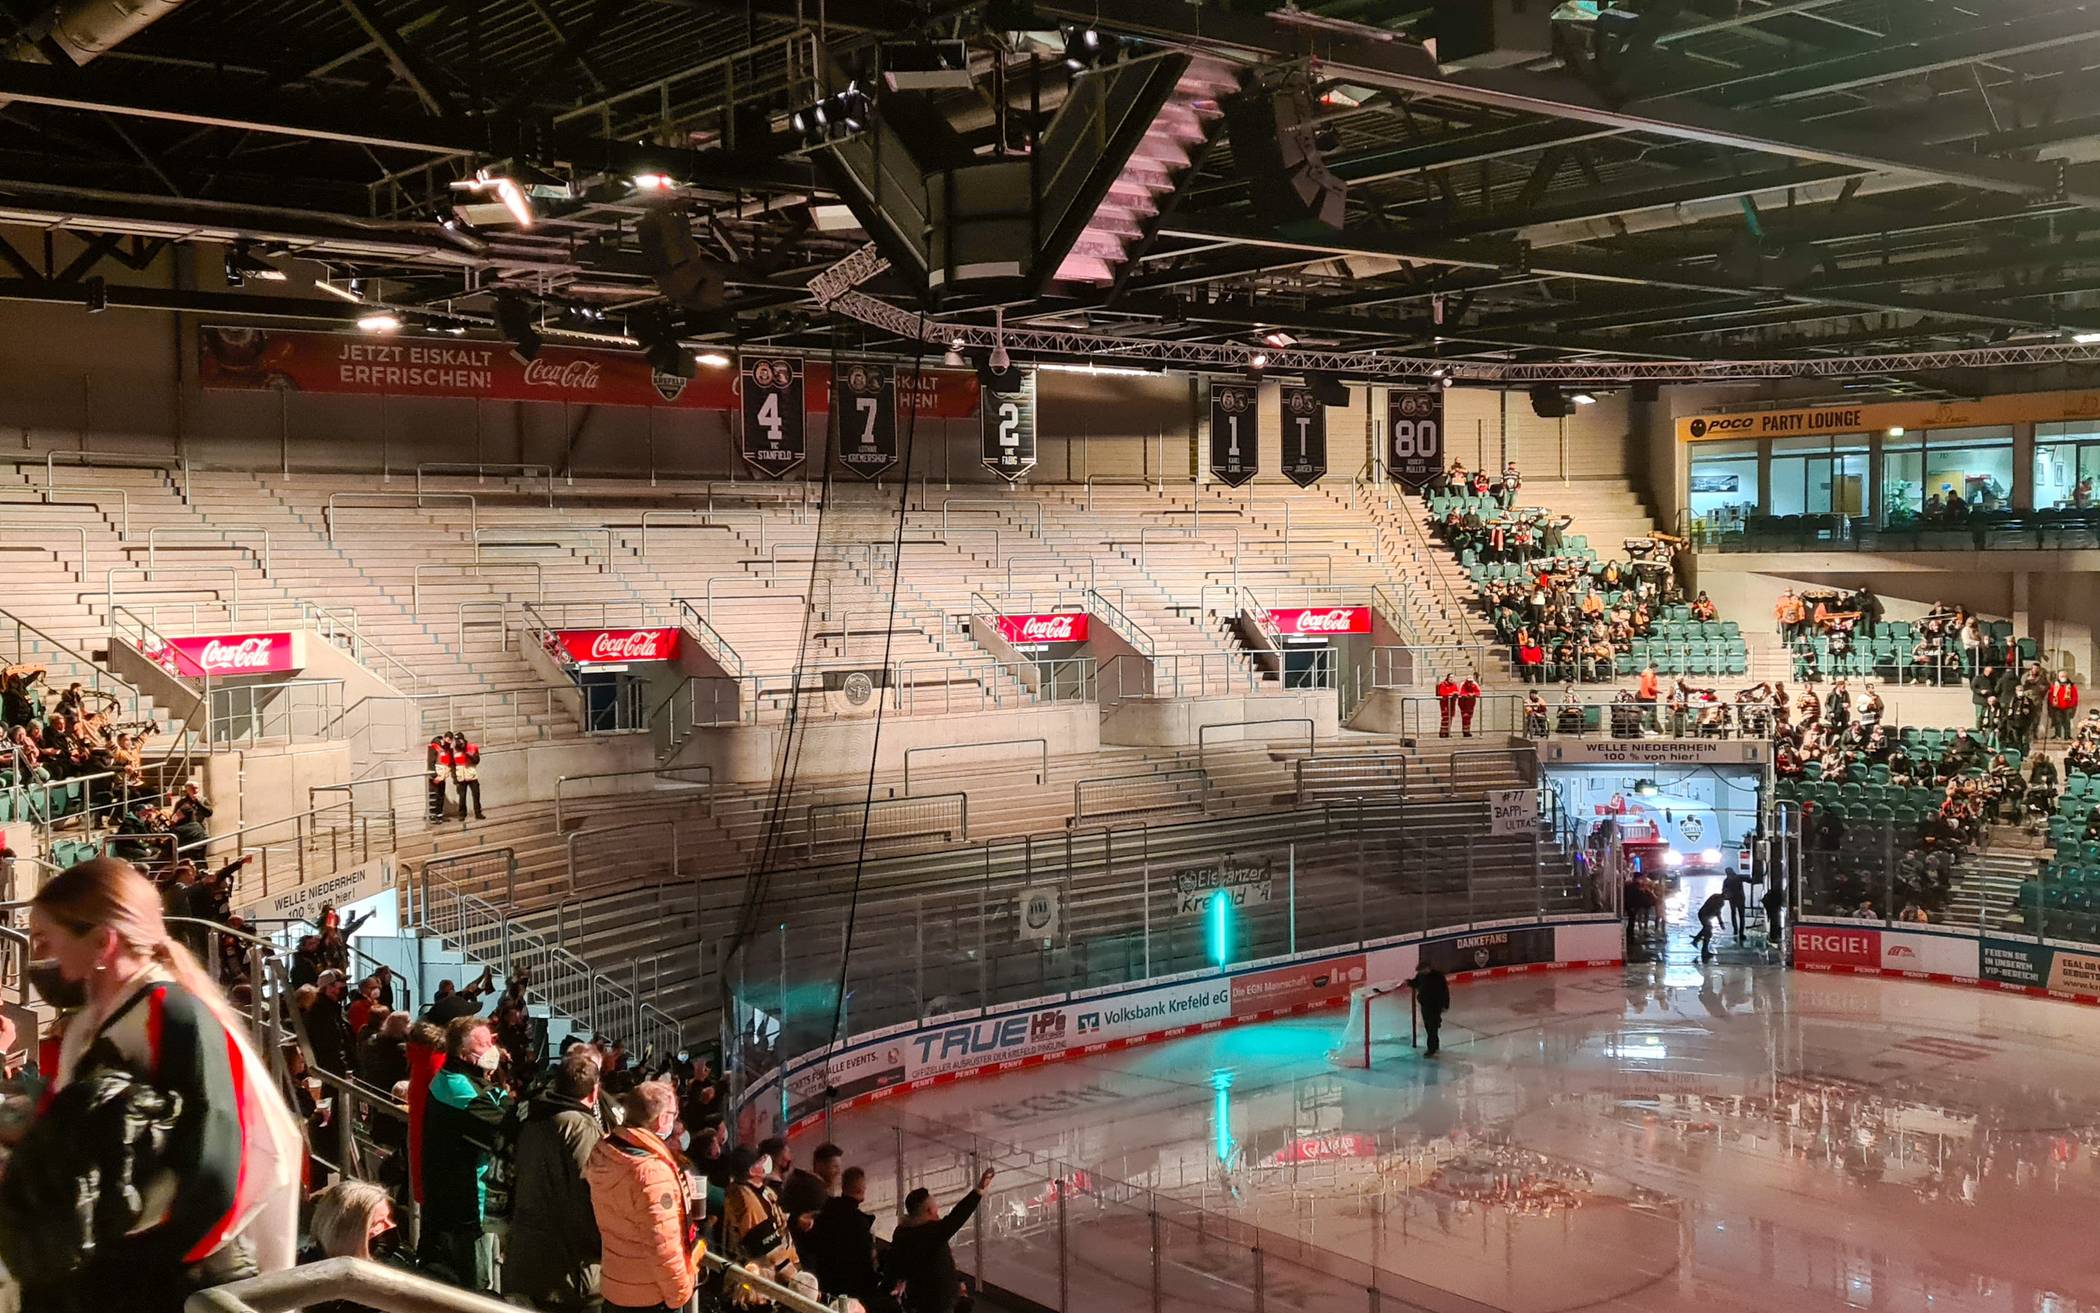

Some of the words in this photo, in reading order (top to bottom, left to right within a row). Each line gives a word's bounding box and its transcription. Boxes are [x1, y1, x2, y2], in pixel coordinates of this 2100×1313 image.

[339, 345, 403, 362] JETZT
[410, 349, 492, 367] EISKALT
[340, 365, 492, 388] ERFRISCHEN!
[524, 358, 600, 389] Coca-Cola
[757, 393, 783, 440] 4
[856, 398, 877, 443] 7
[999, 403, 1019, 446] 2
[1708, 418, 1753, 431] POCO
[1762, 413, 1804, 431] PARTY
[1808, 410, 1861, 429] LOUNGE
[1229, 416, 1240, 456] 1
[1296, 417, 1310, 456] T
[1395, 420, 1437, 457] 80
[758, 450, 791, 461] STANFIELD
[1023, 616, 1074, 639] Coca-Cola
[1297, 610, 1354, 631] Coca-Cola
[201, 638, 272, 669] Coca-Cola
[592, 632, 660, 658] Coca-Cola
[1586, 743, 1628, 752] WELLE
[1632, 743, 1717, 752] NIEDERRHEIN
[1604, 753, 1625, 761] 100
[1671, 753, 1700, 761] hier!
[274, 889, 306, 911] WELLE
[308, 869, 366, 900] NIEDERRHEIN
[335, 887, 355, 905] hier!
[1457, 933, 1508, 949] DANKEFANS
[1985, 947, 2014, 959] FEIERN
[2063, 959, 2083, 970] EGAL
[1985, 966, 2039, 981] VIP-BEREICH!
[1995, 959, 2033, 971] UNSEREM
[1233, 987, 1245, 998] Die
[1246, 983, 1263, 995] EGN
[1104, 999, 1166, 1026] Volksbank
[1168, 991, 1210, 1014] Krefeld
[1213, 990, 1229, 1005] eG
[913, 1016, 1029, 1063] TRUE
